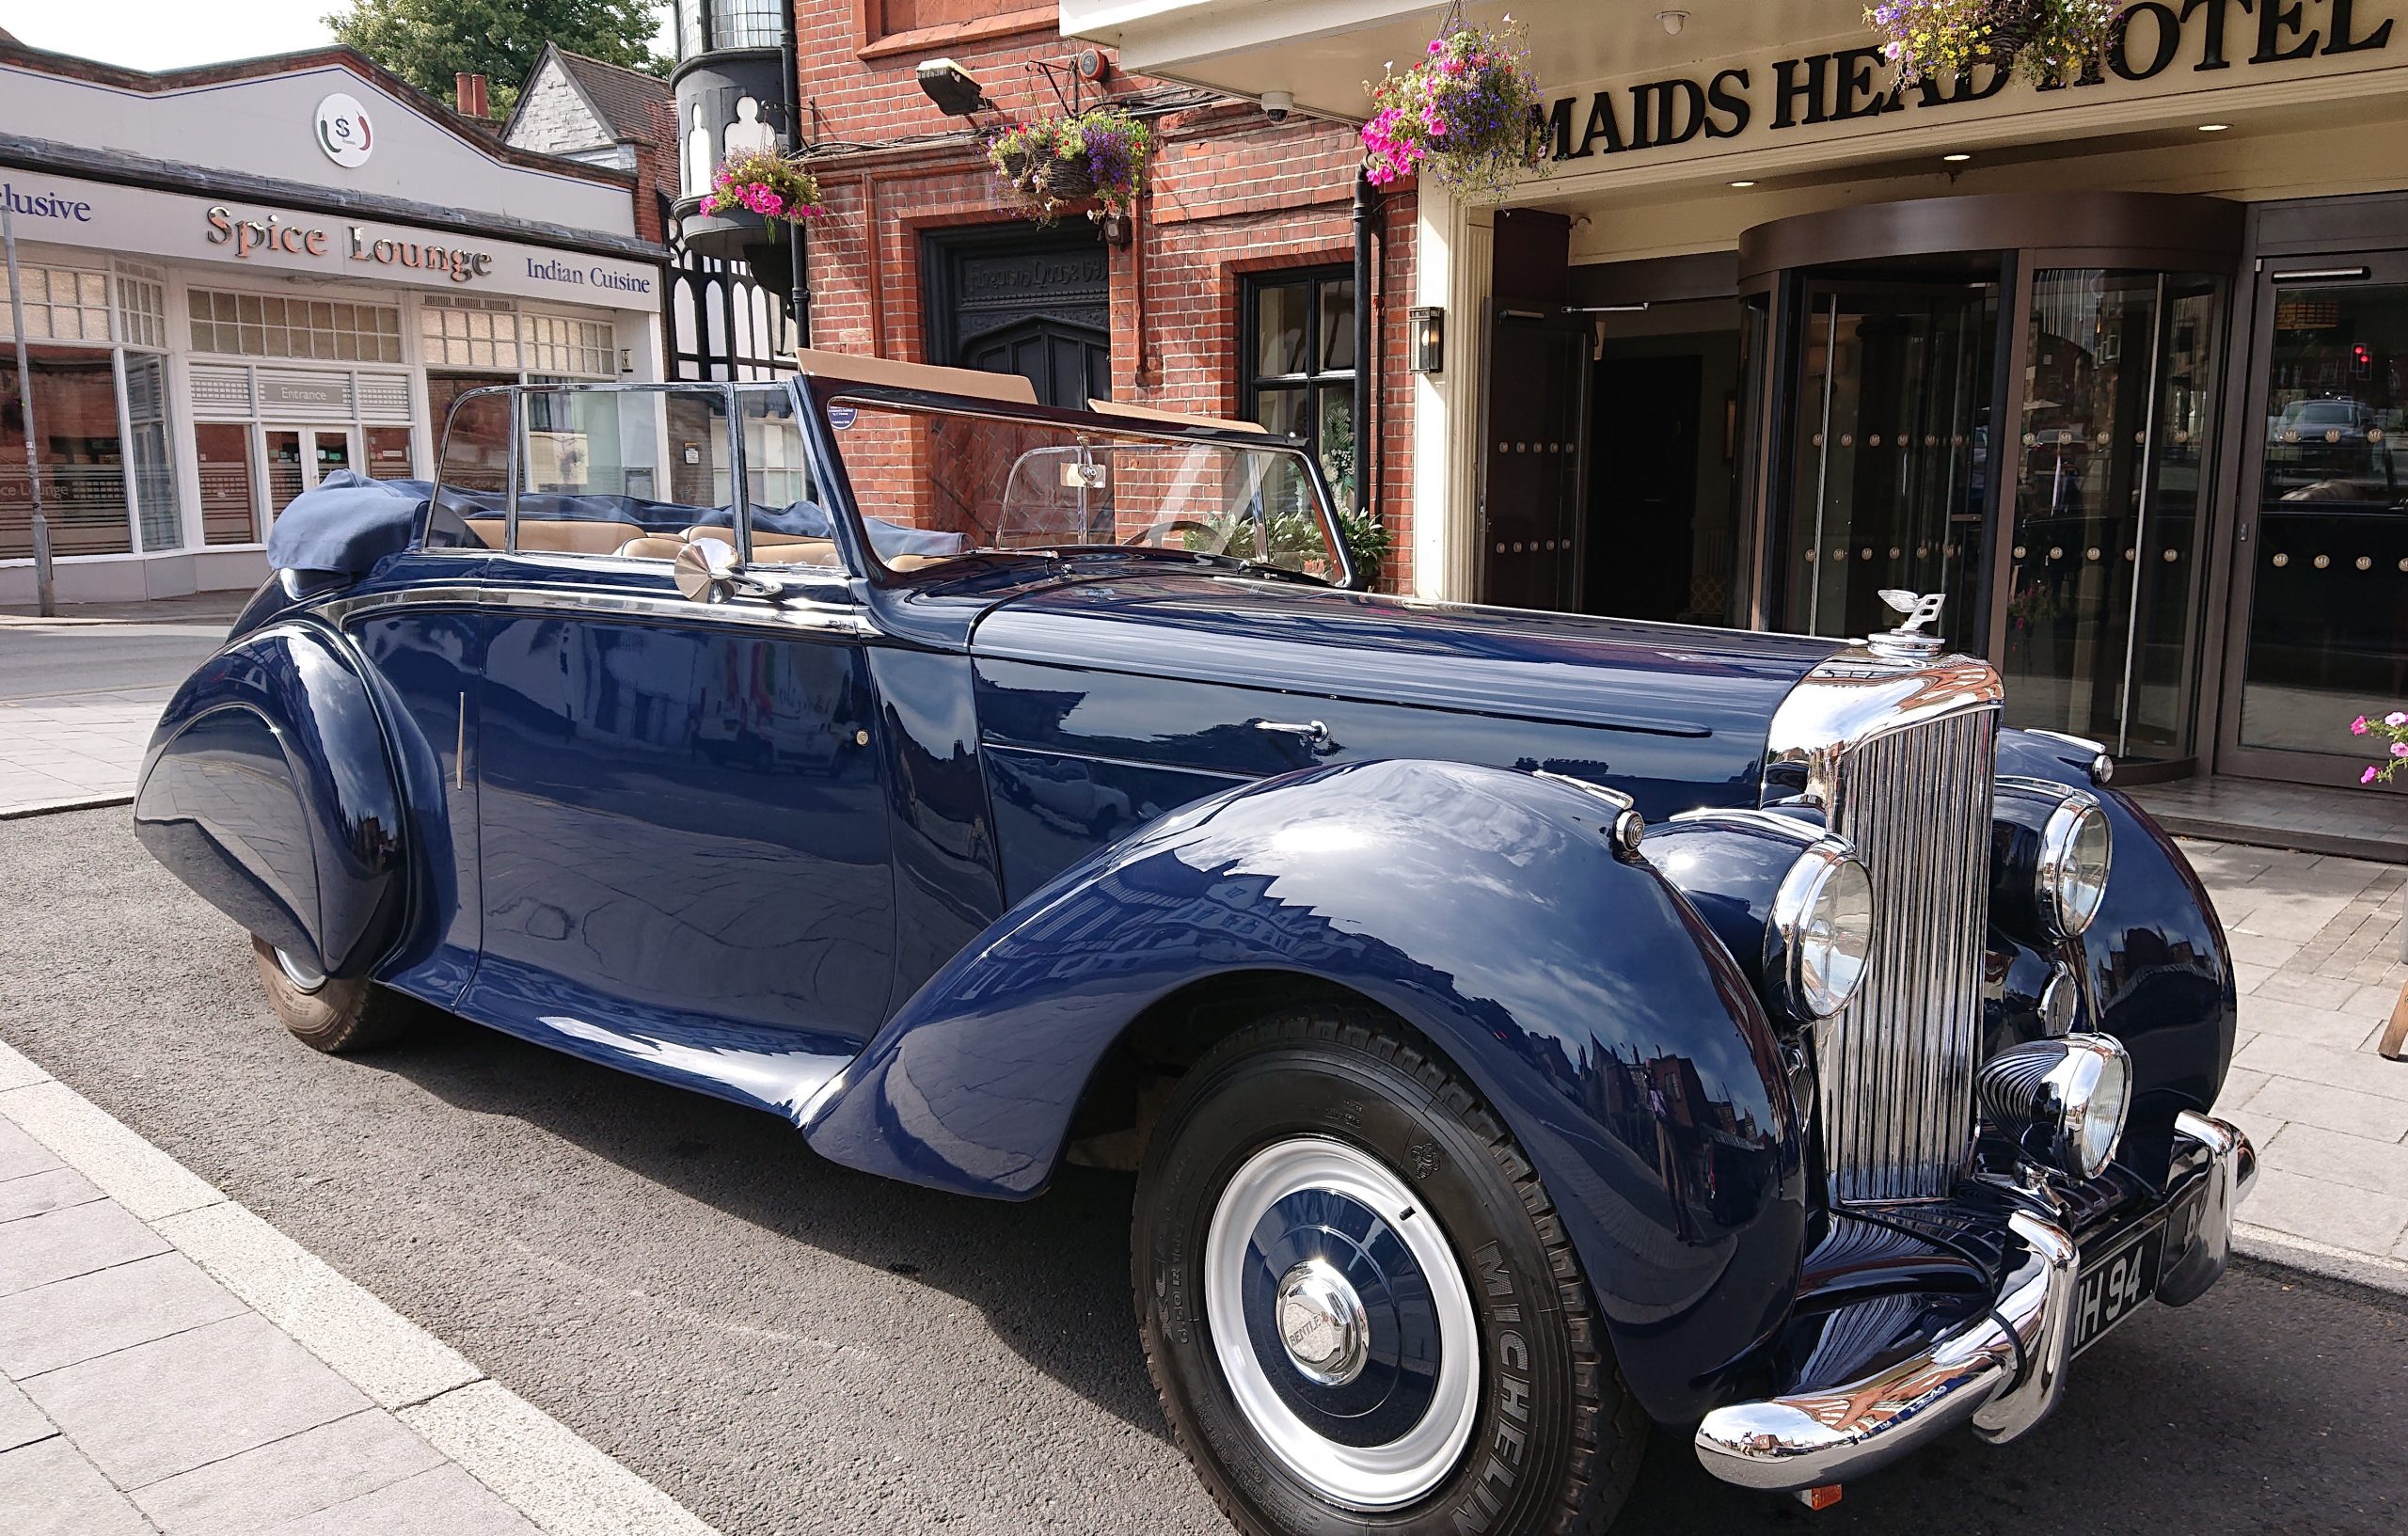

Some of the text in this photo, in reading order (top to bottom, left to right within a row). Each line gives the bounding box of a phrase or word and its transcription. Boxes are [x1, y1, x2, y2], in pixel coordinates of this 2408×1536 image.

[1524, 69, 1751, 161] MAIDS
[2036, 0, 2394, 91] OTEL
[0, 182, 651, 293] lusive Spice Lounge Indian Cuisine
[281, 387, 328, 401] Entrance
[2106, 1243, 2144, 1322] 94
[1451, 1240, 1530, 1536] MICHELIN
